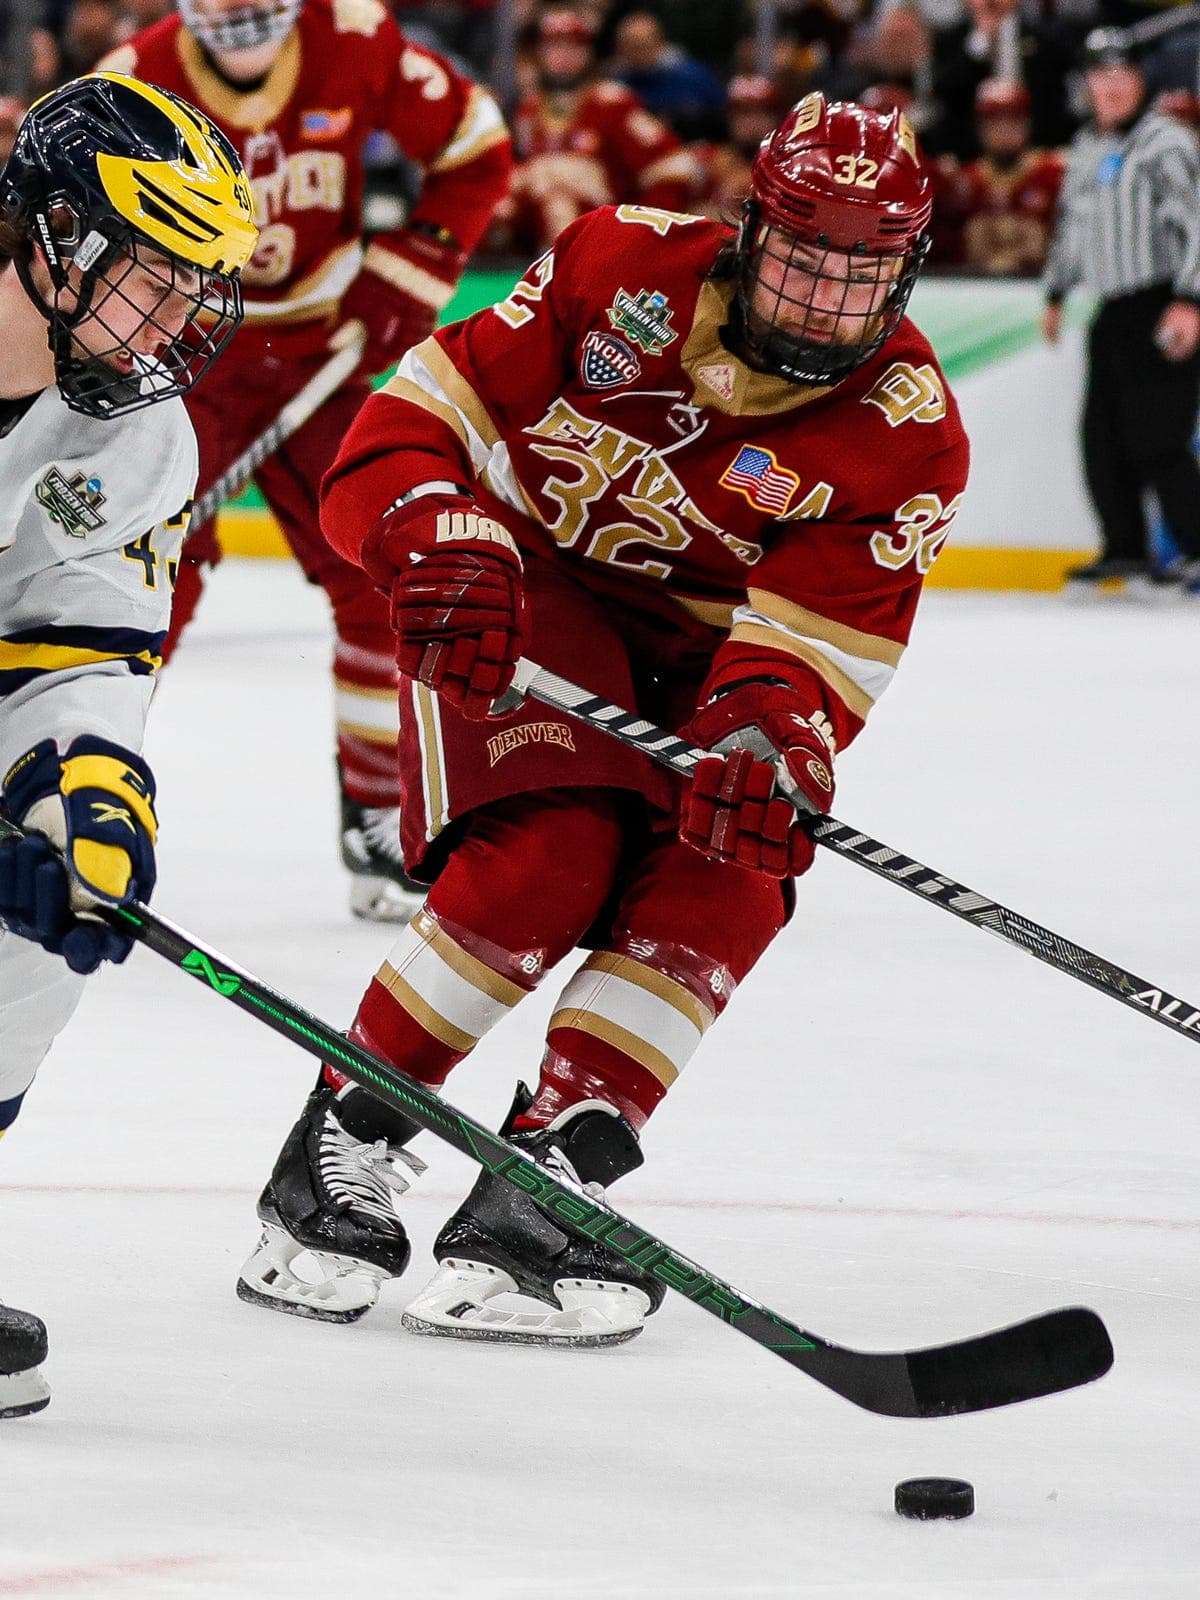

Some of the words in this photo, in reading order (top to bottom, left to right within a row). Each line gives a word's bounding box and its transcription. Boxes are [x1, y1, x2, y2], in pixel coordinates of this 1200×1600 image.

[833, 153, 879, 190] 32
[233, 182, 250, 212] 43
[618, 298, 652, 326] FROZEN
[586, 335, 638, 380] NCHC
[48, 476, 81, 509] FROZEN
[527, 442, 694, 580] 32
[868, 492, 967, 576] 32
[486, 722, 577, 768] DENVER
[505, 1158, 753, 1326] BAUER
